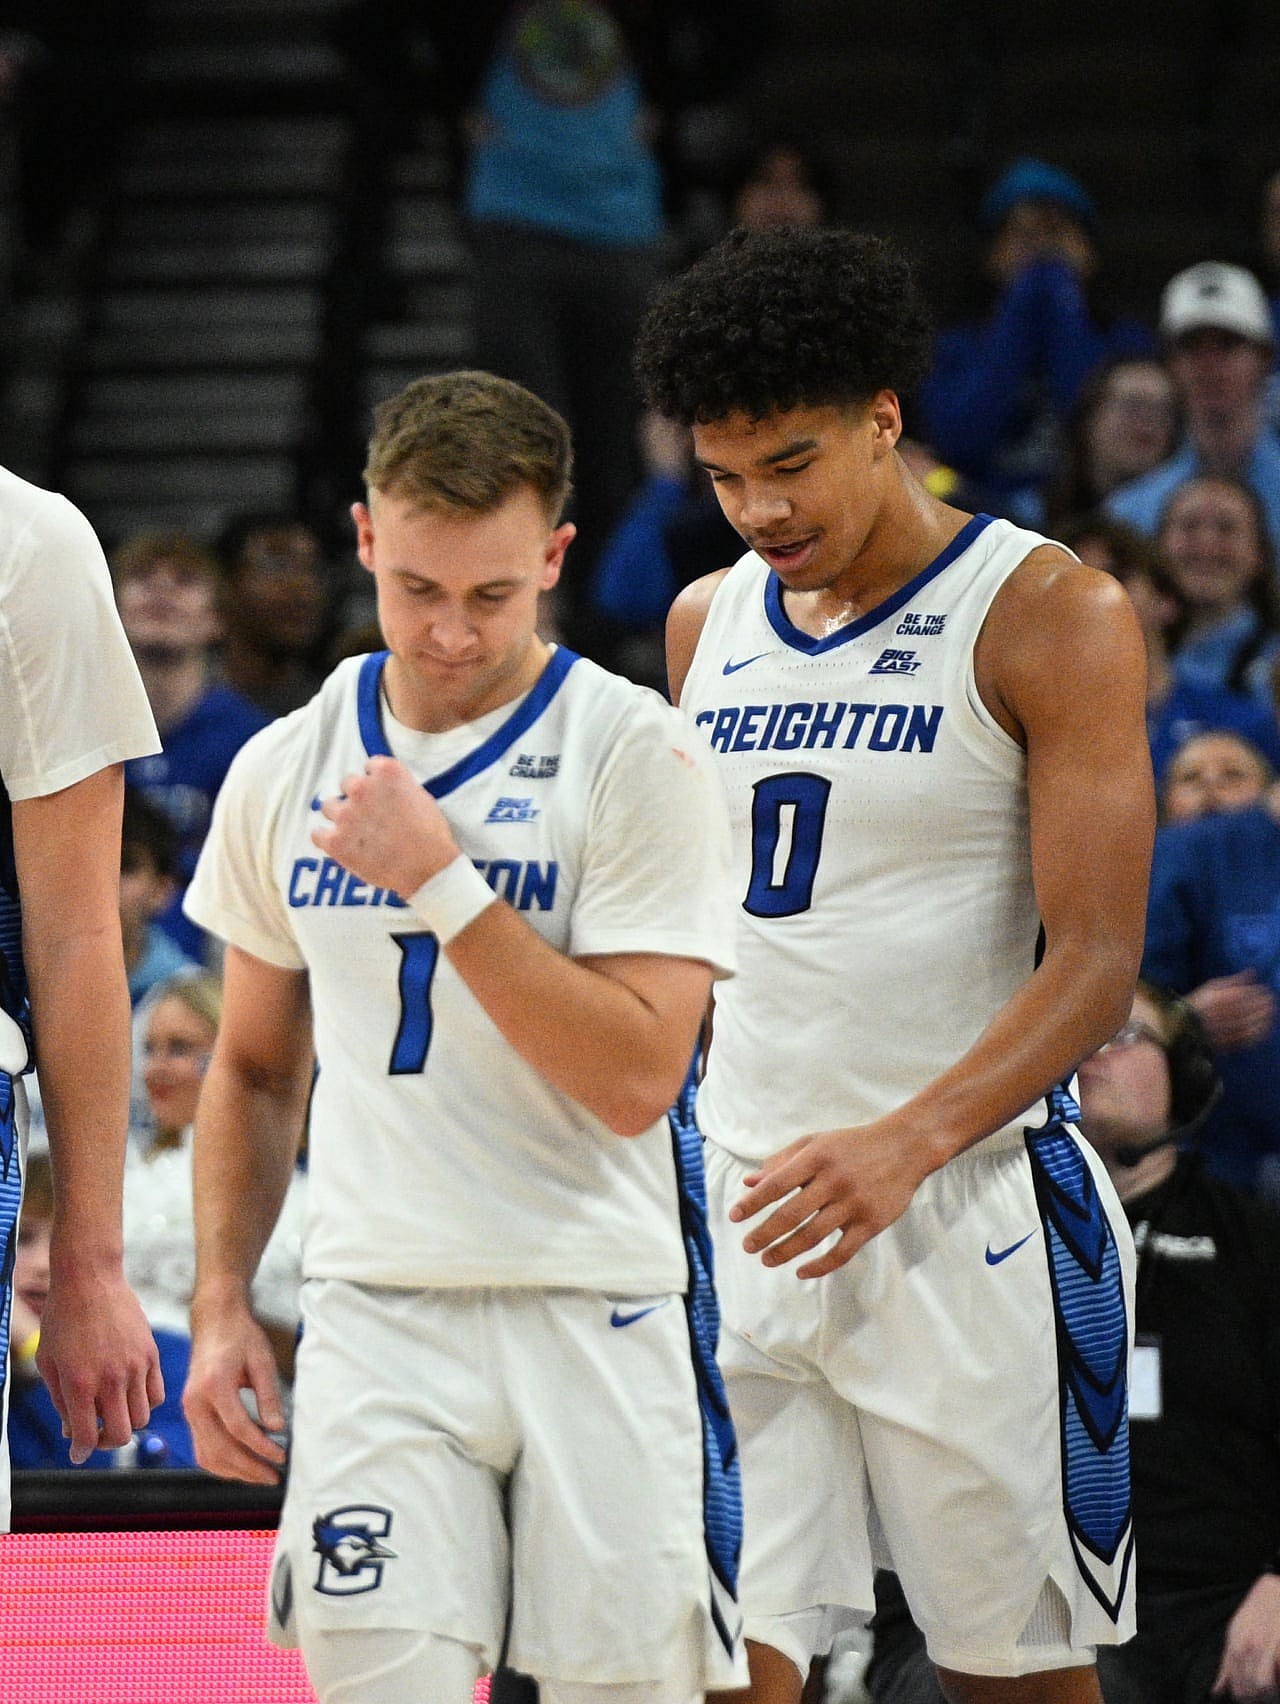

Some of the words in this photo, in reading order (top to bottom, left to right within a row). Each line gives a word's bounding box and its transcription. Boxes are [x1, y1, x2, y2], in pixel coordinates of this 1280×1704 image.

[903, 612, 922, 624] BE
[924, 613, 948, 625] THE
[895, 623, 946, 636] CHANGE
[879, 648, 917, 661] BIG
[871, 659, 923, 672] EAST
[741, 771, 832, 918] 0
[388, 930, 441, 1076] 1
